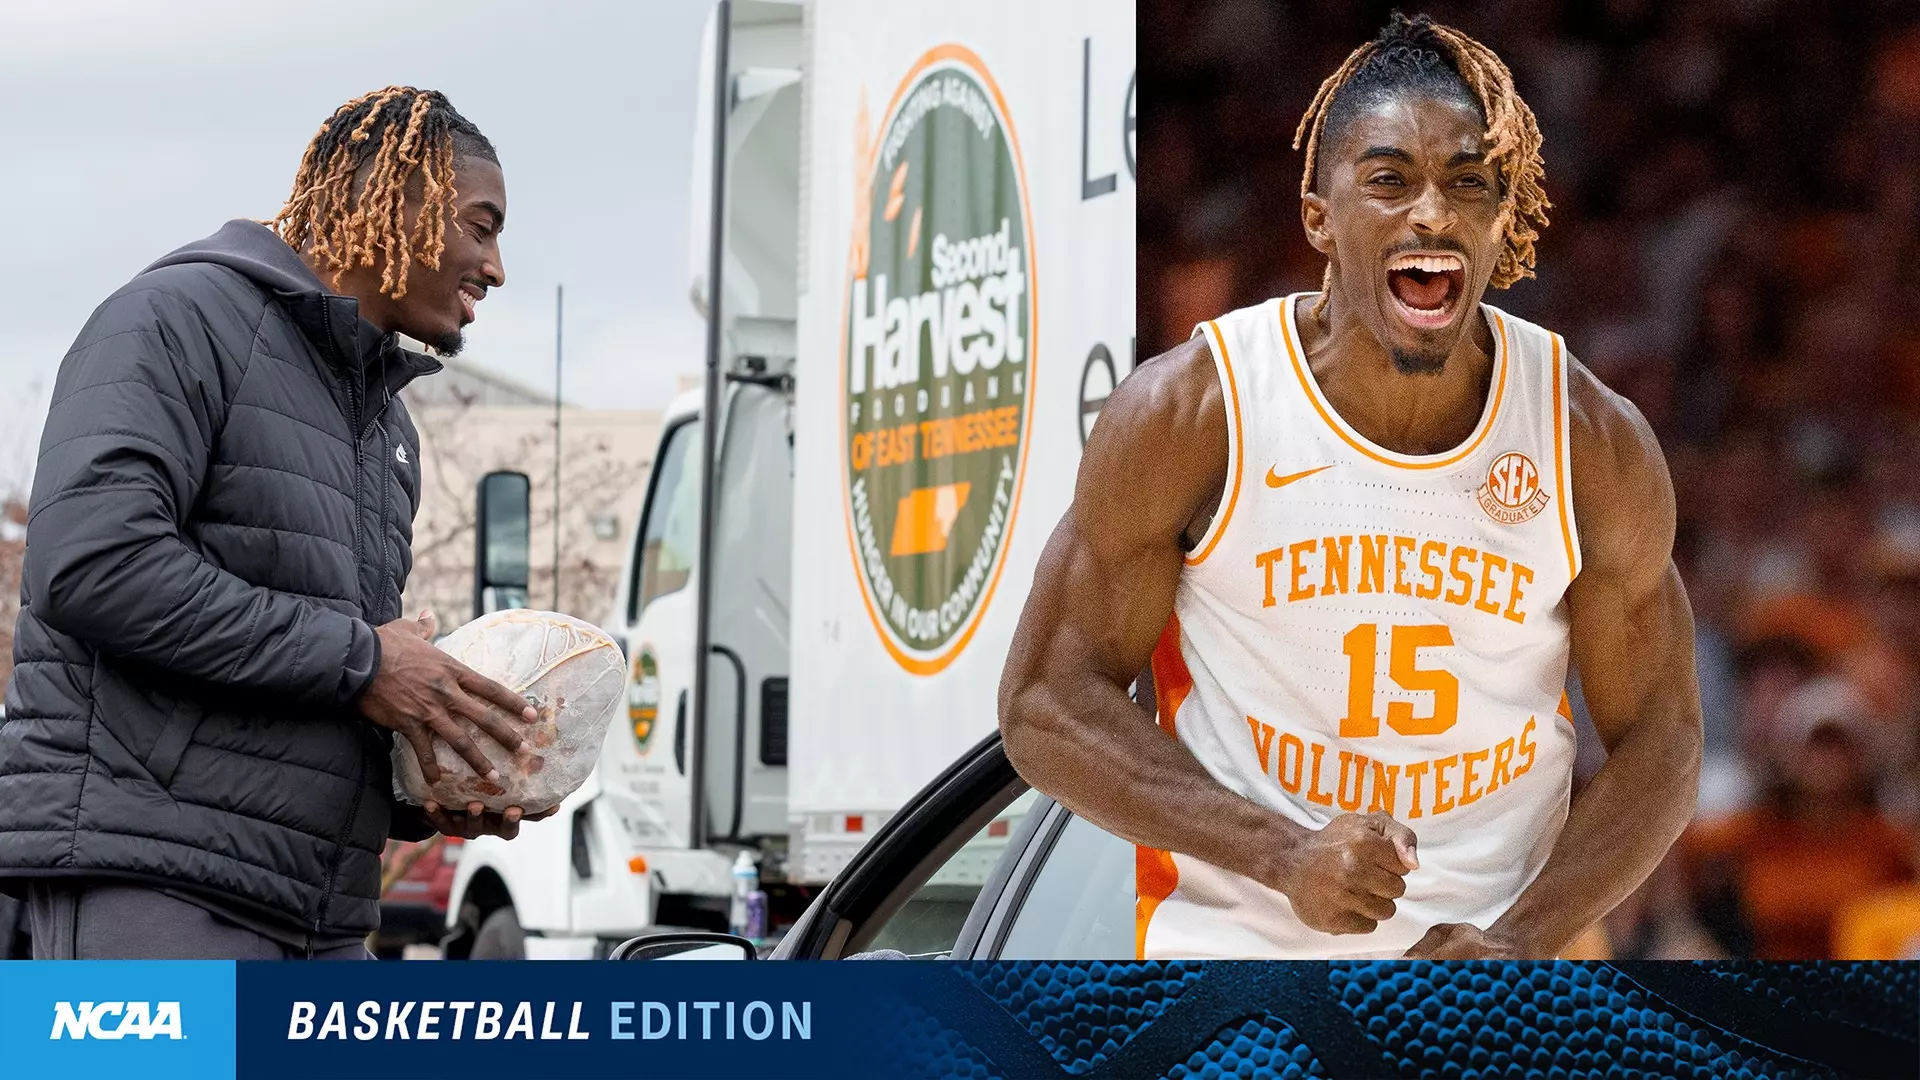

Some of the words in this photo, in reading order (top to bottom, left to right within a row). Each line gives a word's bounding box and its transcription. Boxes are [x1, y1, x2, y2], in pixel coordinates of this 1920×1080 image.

[931, 216, 1010, 288] Second
[852, 247, 1024, 394] Harvest
[852, 430, 876, 471] OF
[875, 423, 918, 467] EAST
[919, 405, 1020, 461] TENNESSEE
[1492, 455, 1536, 505] SEC
[852, 477, 893, 610] HUNGER
[890, 593, 908, 631] IN
[907, 607, 940, 641] OUR
[939, 454, 1013, 633] COMMUNITY
[1484, 498, 1538, 522] GRADUATE
[1255, 534, 1535, 625] TENNESSEE
[1339, 622, 1459, 738] 15
[1246, 714, 1538, 820] VOLUNTEERS
